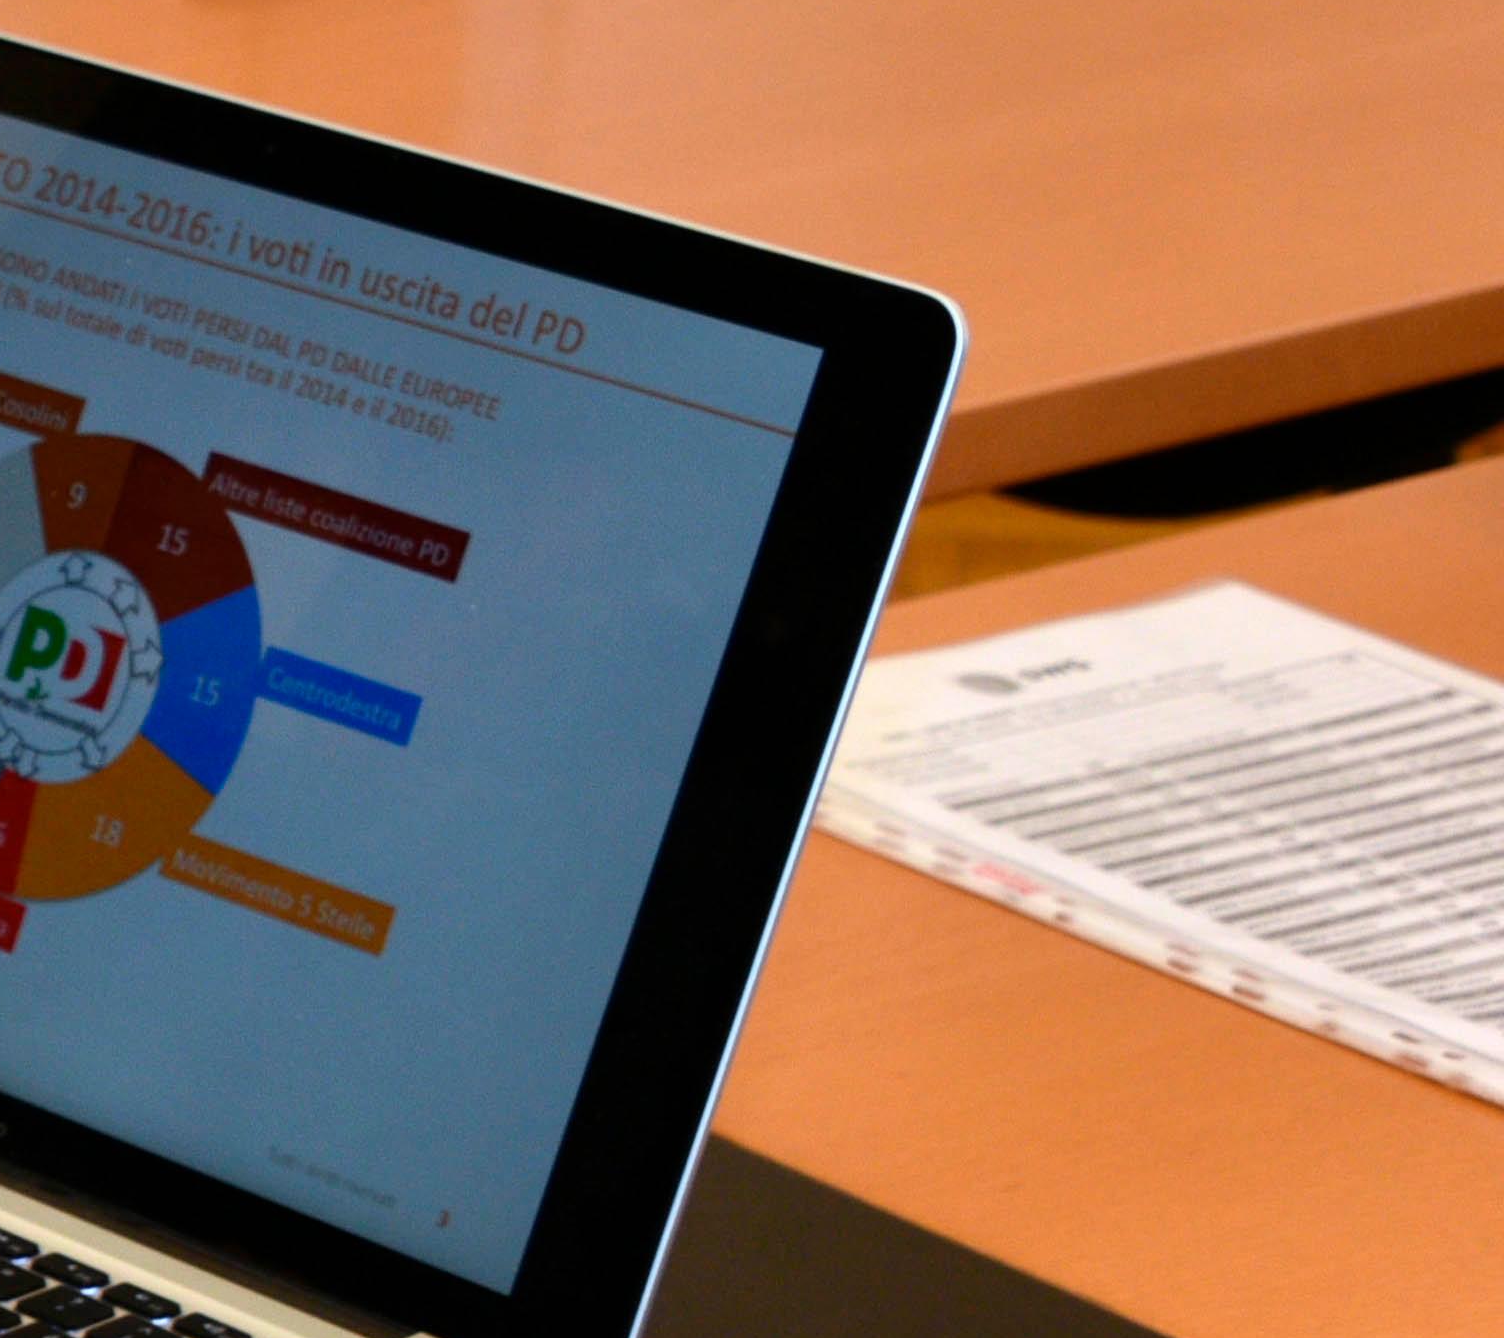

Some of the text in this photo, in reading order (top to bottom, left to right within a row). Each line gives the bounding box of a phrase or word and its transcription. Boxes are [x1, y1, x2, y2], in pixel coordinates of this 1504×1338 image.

[34, 164, 223, 251] 2014-2016:
[227, 220, 242, 253] i
[247, 232, 313, 276] voti
[317, 246, 352, 290] in
[358, 264, 459, 322] uscita
[468, 292, 529, 339] del
[532, 307, 587, 356] PD
[50, 267, 128, 304] ANDATI
[143, 292, 190, 324] VOTI
[193, 307, 250, 343] PERSI
[253, 325, 291, 358] DAL
[296, 340, 329, 368] PD
[331, 351, 399, 390] DALLE
[400, 369, 501, 423] EUROPEE
[65, 306, 126, 340] totale
[127, 322, 149, 346] di
[151, 337, 189, 360] voti
[191, 346, 242, 378] persi
[246, 361, 274, 387] tra
[277, 369, 294, 391] il
[295, 374, 350, 409] 2014
[351, 396, 367, 416] e
[67, 481, 87, 509] 9
[207, 472, 451, 569] Altre liste coalizione PD
[156, 523, 189, 557] 15
[189, 676, 221, 708] 15
[268, 666, 404, 733] Centrodestra
[90, 814, 125, 849] 18
[172, 848, 377, 941] MoVimento 5 Stelle
